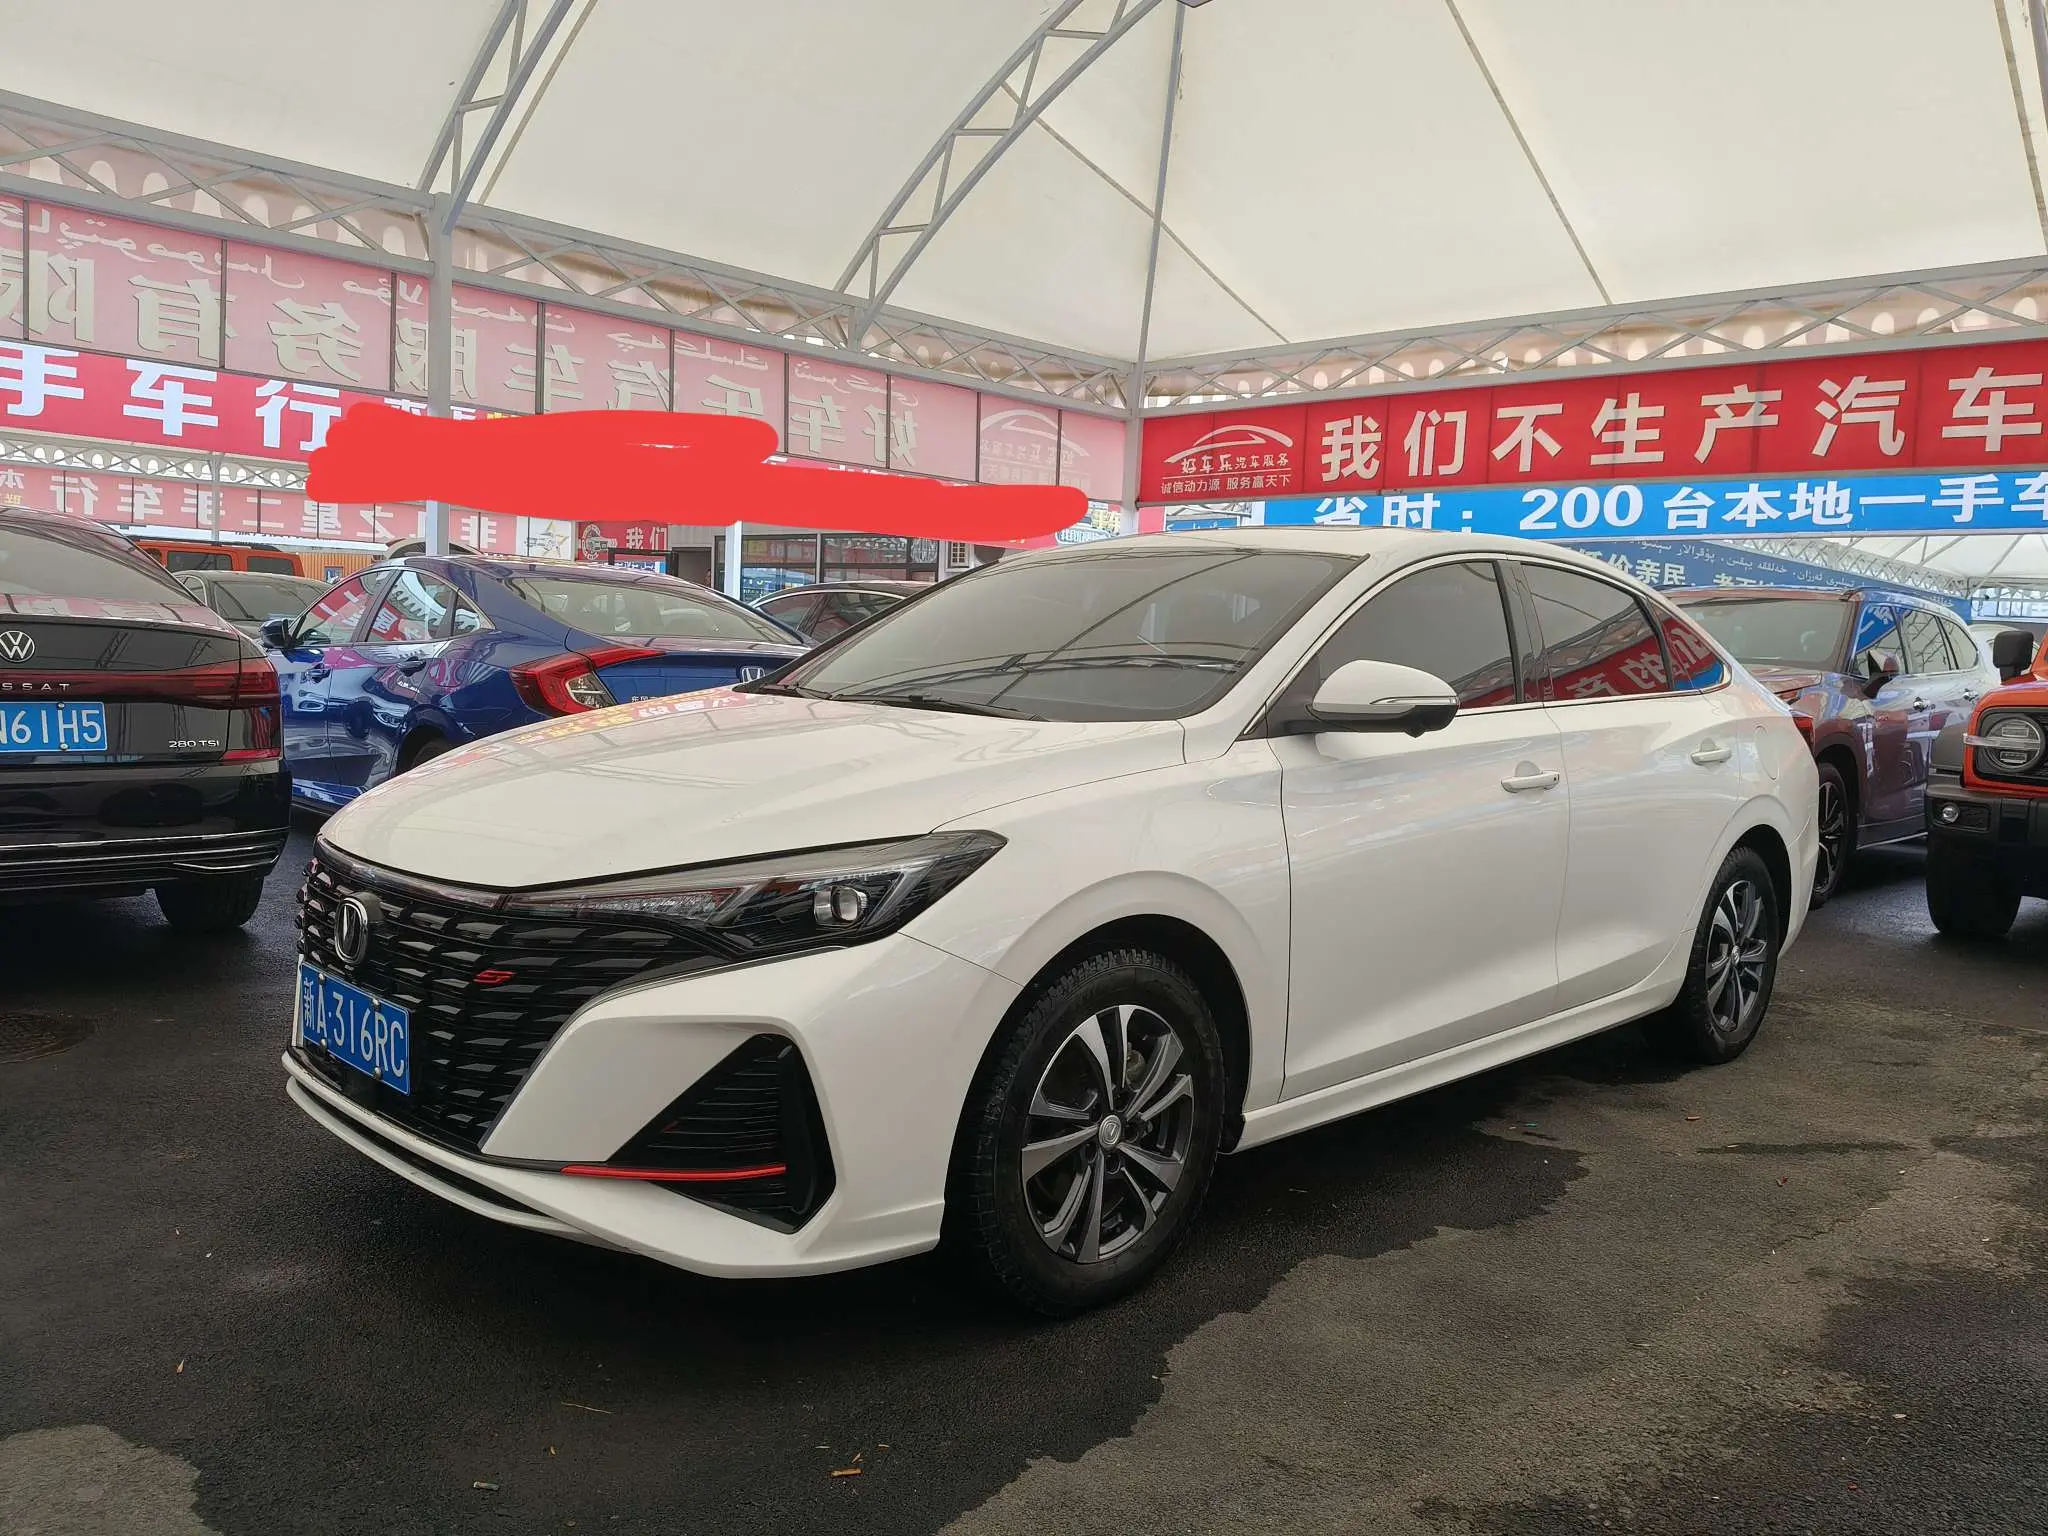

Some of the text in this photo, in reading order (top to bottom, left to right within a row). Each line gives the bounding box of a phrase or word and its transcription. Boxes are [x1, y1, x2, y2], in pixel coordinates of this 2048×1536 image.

[1321, 366, 2043, 483] 我们不生产汽车
[168, 740, 196, 748] 280
